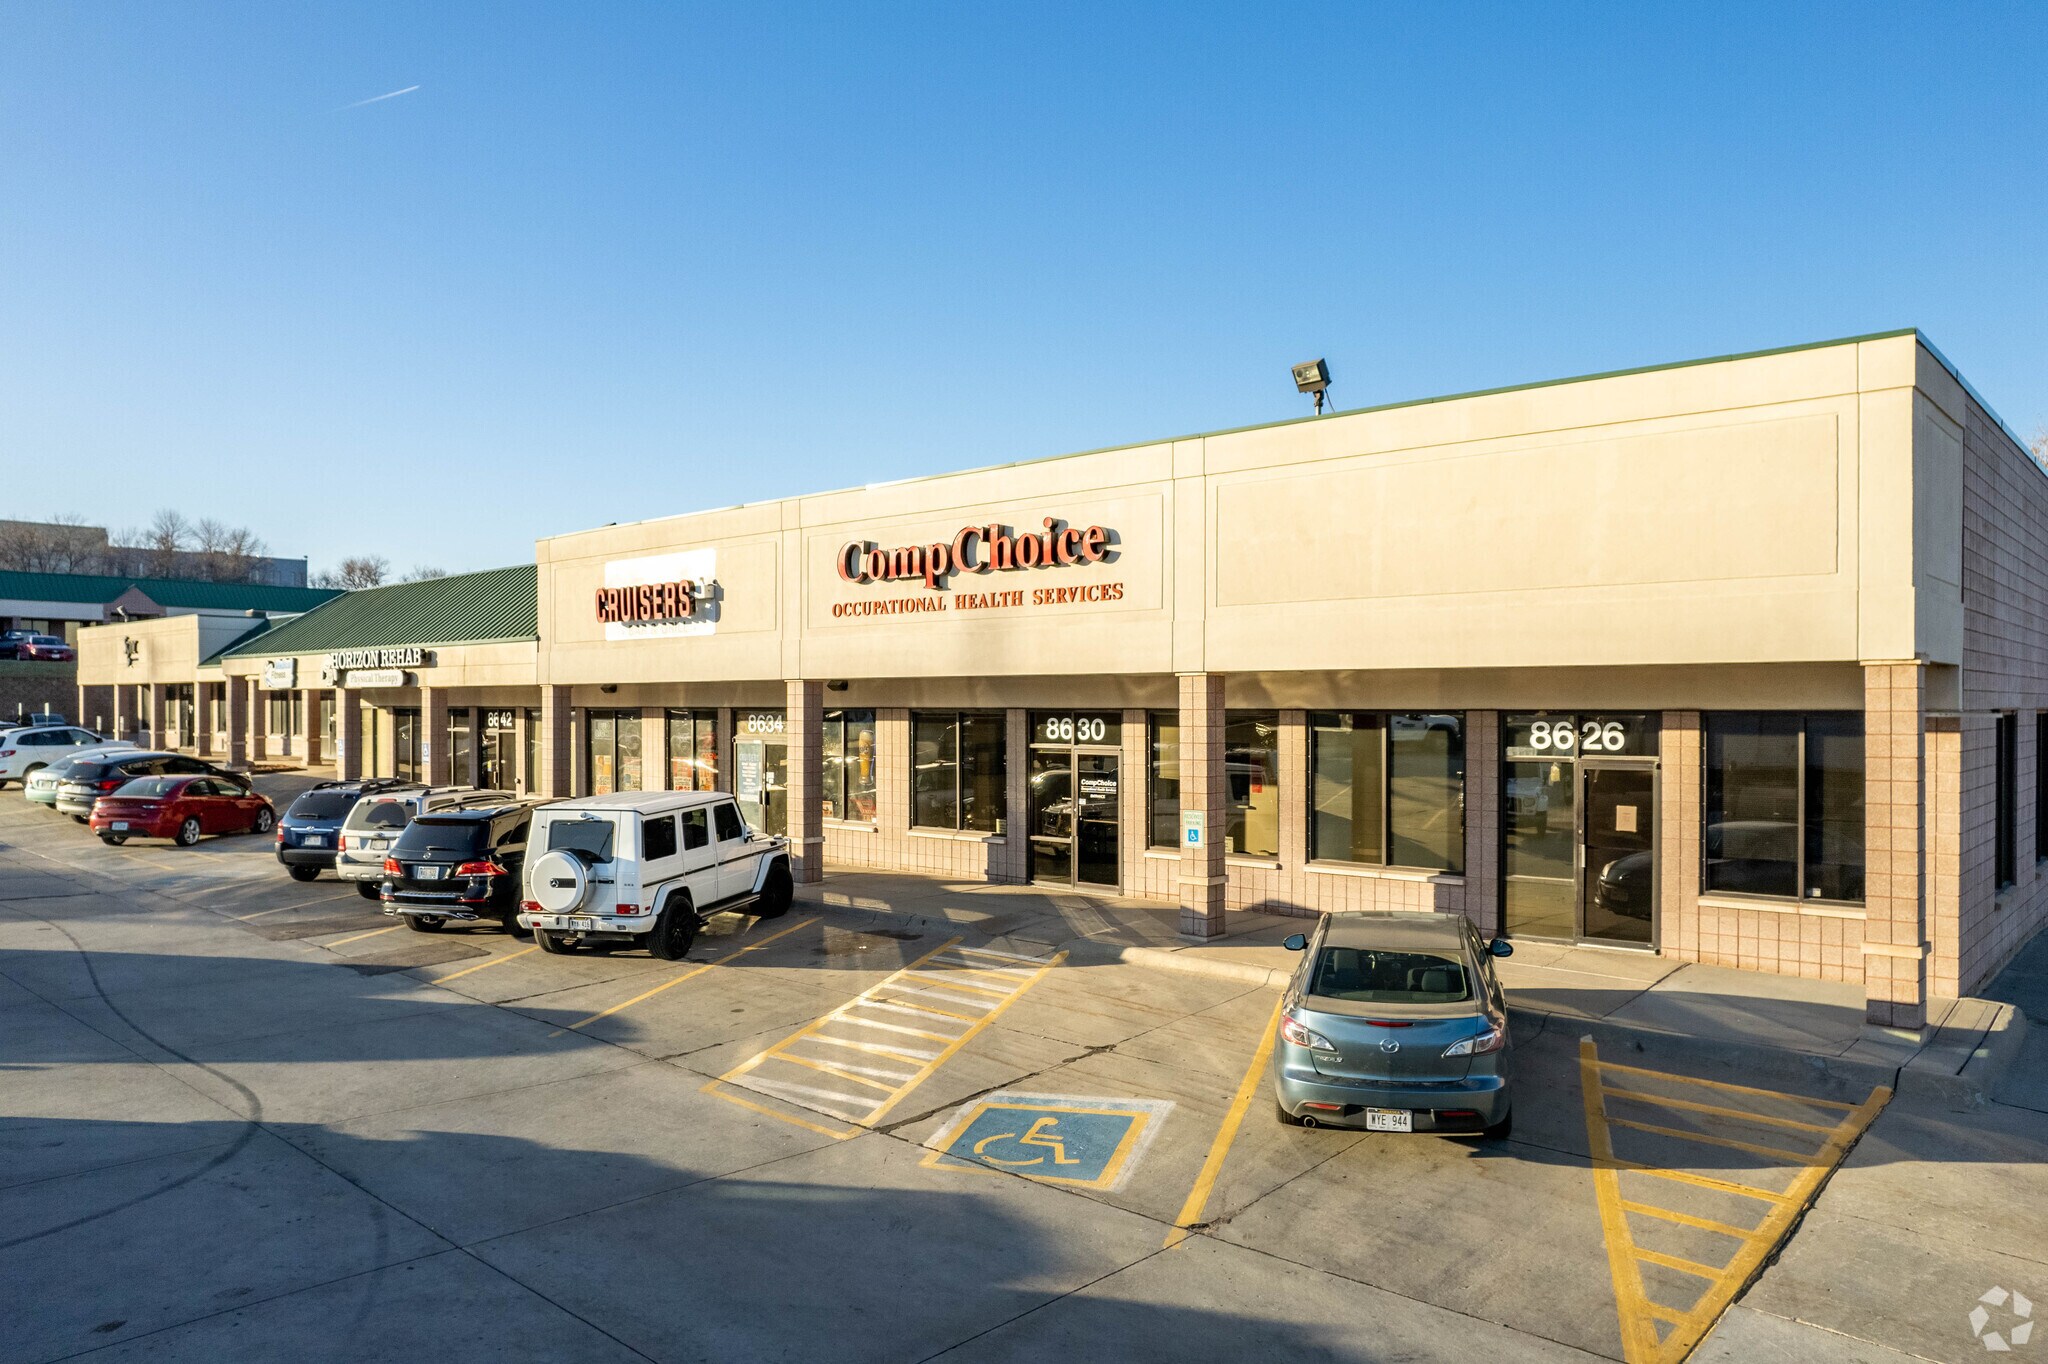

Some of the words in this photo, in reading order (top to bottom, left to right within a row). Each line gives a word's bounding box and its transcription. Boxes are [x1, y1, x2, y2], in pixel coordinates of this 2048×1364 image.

[837, 517, 1107, 590] CompChoice
[595, 579, 692, 623] CRUISERS
[832, 596, 946, 617] OCCUPATIONAL
[954, 590, 1024, 610] HEALTH
[1033, 582, 1124, 606] SERVICES
[331, 649, 379, 669] HORIZON
[380, 648, 421, 667] REHAB
[350, 672, 374, 685] Physical
[374, 671, 398, 684] Therapy
[488, 712, 512, 727] 8642
[748, 714, 783, 733] 8634
[1046, 718, 1105, 740] 8630
[1530, 721, 1625, 750] 8626
[1081, 779, 1117, 787] CompChoice
[1371, 1114, 1387, 1125] WYE
[1392, 1115, 1408, 1126] 944
